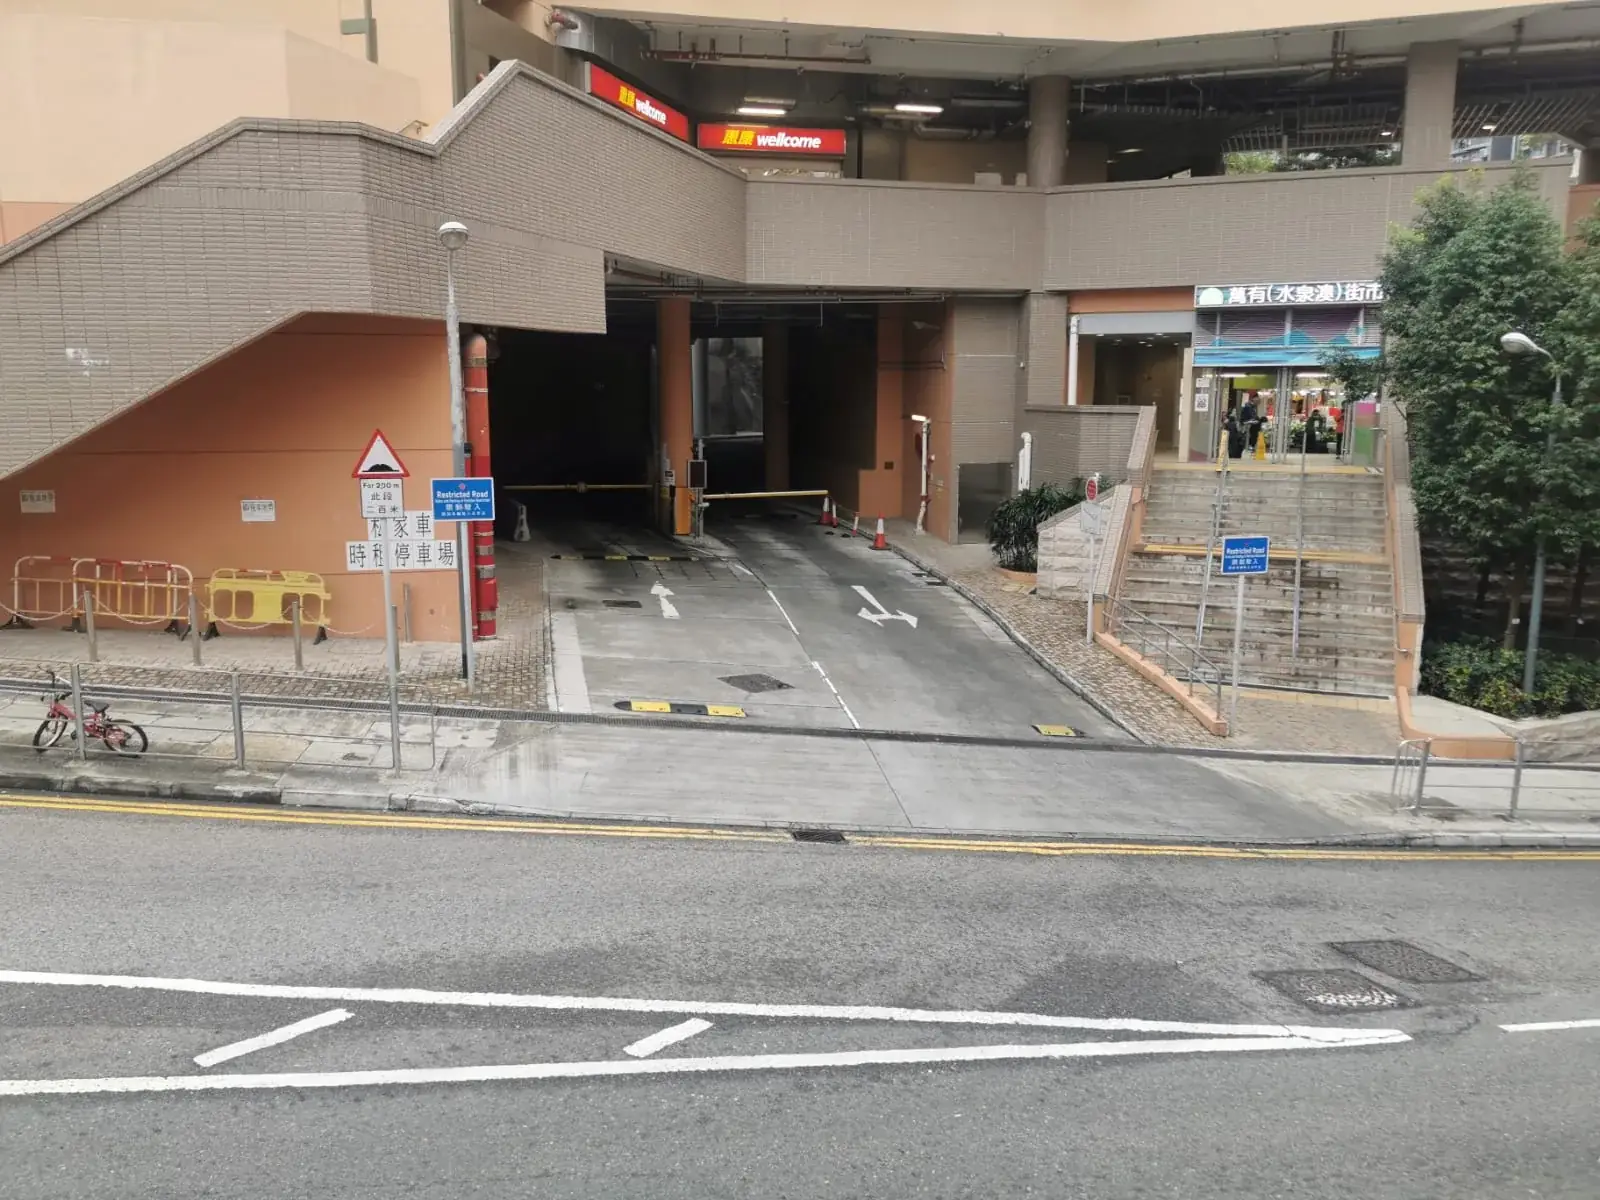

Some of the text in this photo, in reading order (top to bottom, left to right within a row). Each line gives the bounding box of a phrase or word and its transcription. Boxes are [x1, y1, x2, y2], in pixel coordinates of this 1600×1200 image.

[757, 132, 821, 149] wellcome
[436, 490, 489, 499] Restricted Road
[367, 504, 400, 514] 二百米
